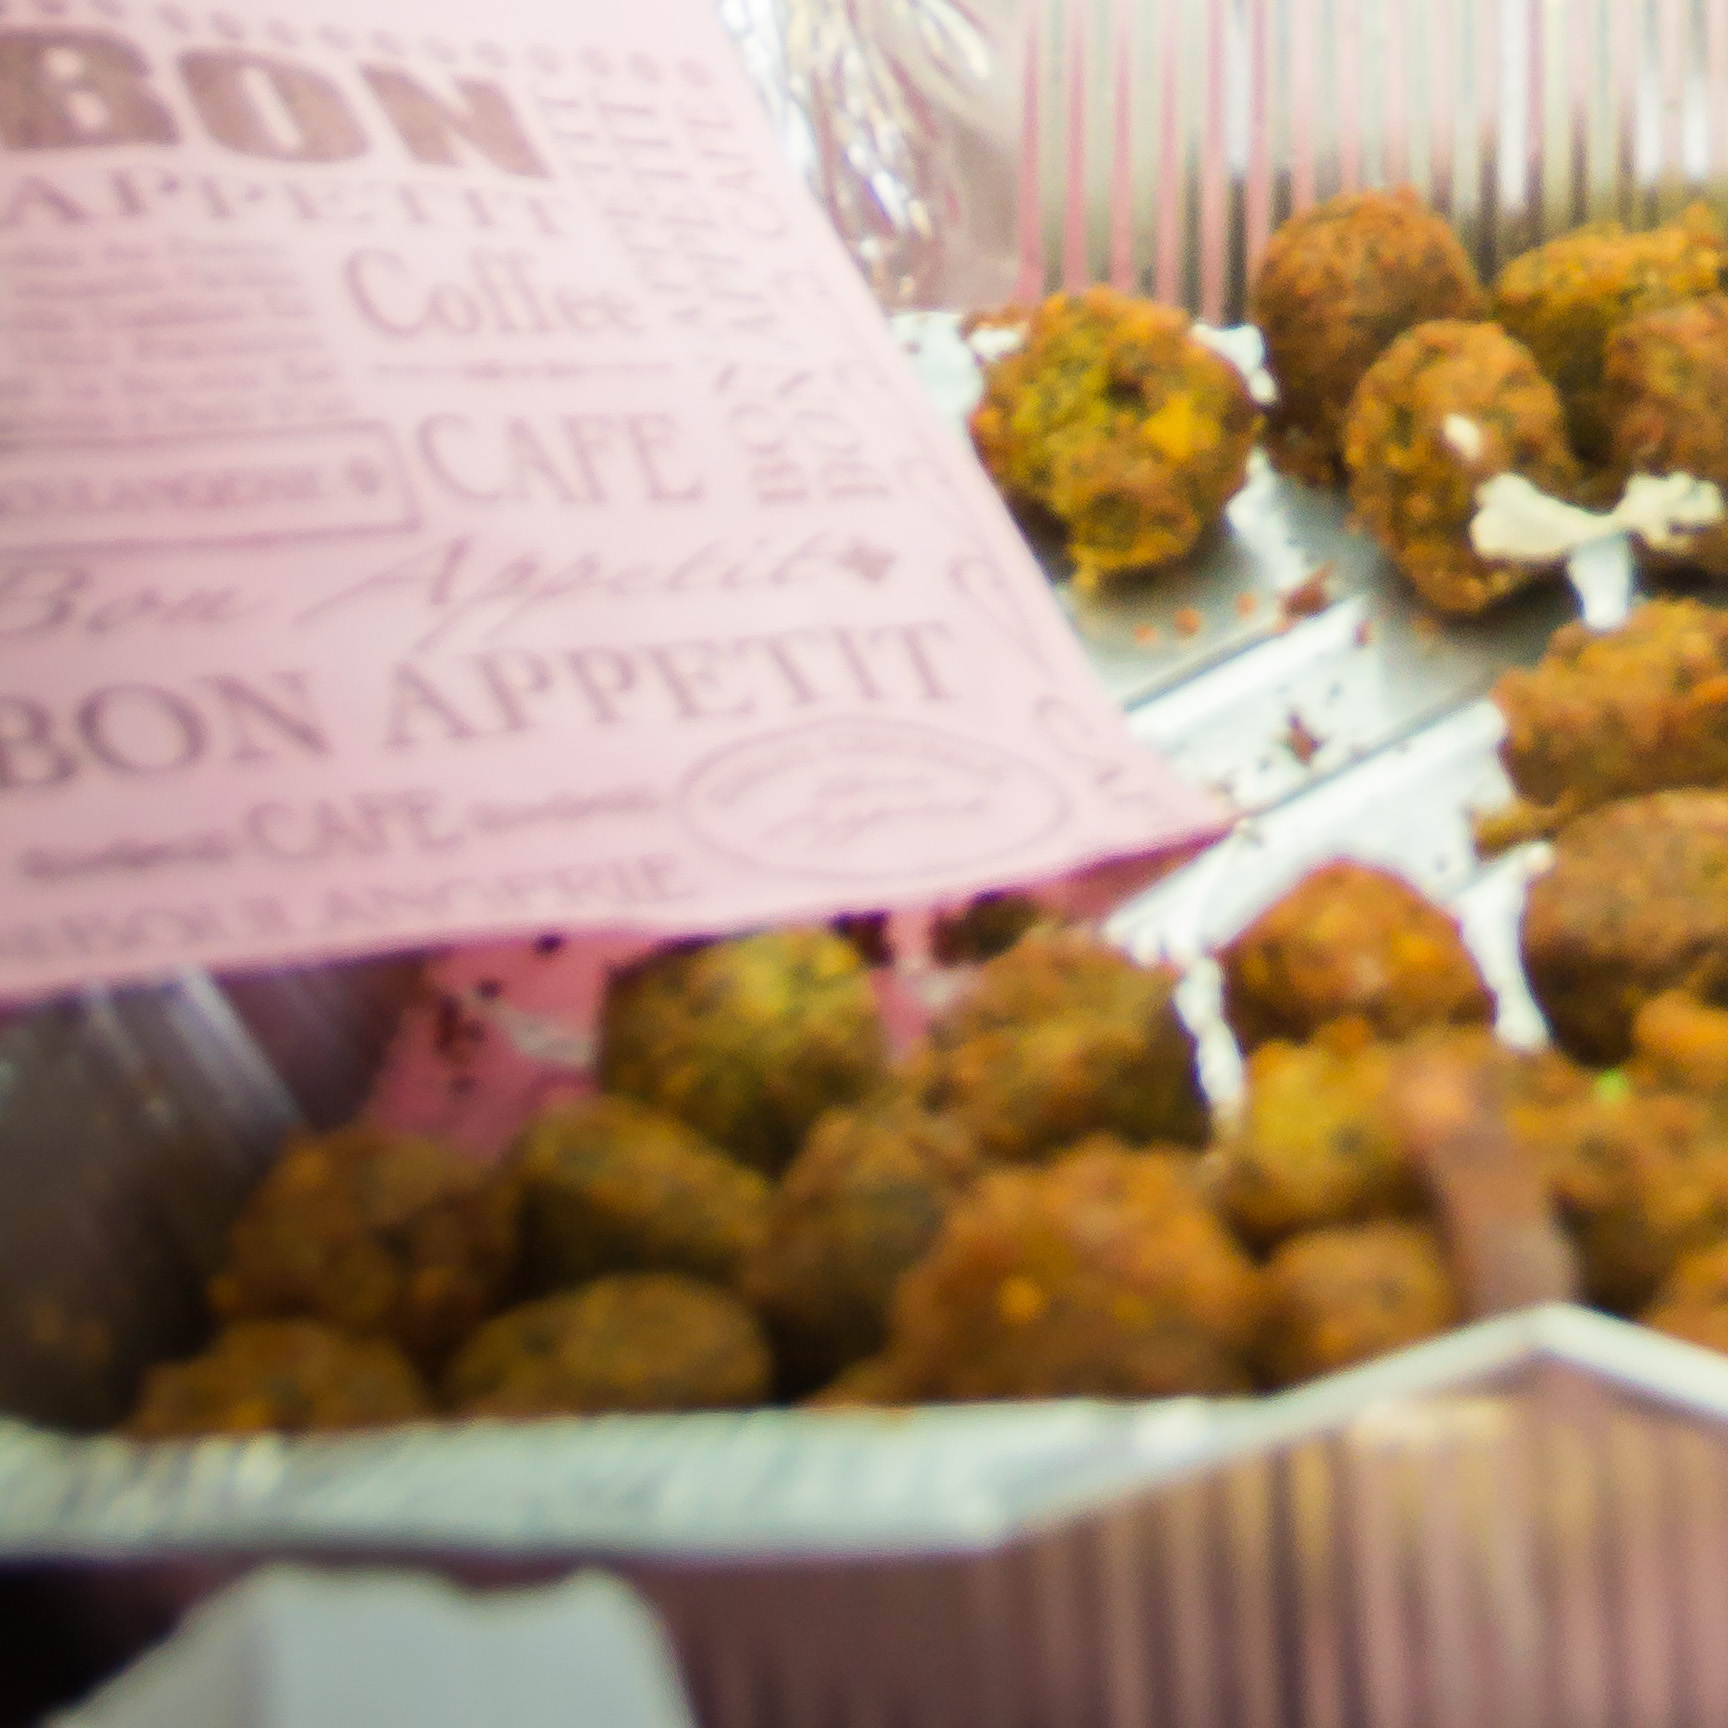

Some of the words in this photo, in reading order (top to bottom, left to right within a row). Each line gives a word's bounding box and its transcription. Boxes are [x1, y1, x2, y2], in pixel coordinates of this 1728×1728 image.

[0, 27, 555, 180] BON
[0, 167, 571, 237] APPETIT
[342, 245, 645, 341] Coffee
[415, 408, 706, 509] CAFE
[293, 534, 840, 656] Appetit
[0, 670, 333, 792] BON
[384, 622, 960, 748] APPETIT
[243, 790, 462, 862] CAFE
